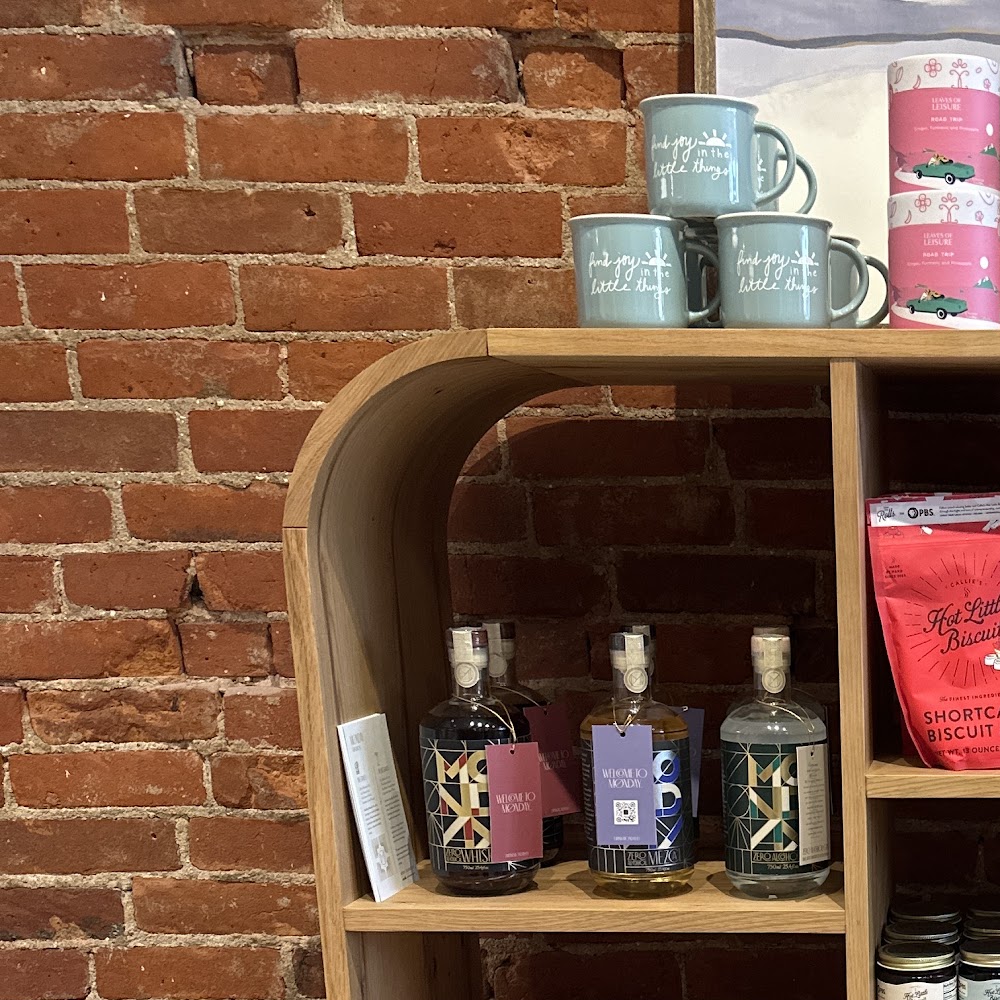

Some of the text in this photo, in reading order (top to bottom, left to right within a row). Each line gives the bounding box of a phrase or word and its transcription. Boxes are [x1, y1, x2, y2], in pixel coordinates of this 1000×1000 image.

[651, 133, 698, 160] find joy
[697, 149, 730, 159] in the
[652, 156, 731, 180] little things
[919, 508, 934, 517] PBS
[923, 603, 962, 636] Hot
[927, 724, 994, 742] BISCUIT
[635, 768, 648, 778] TO
